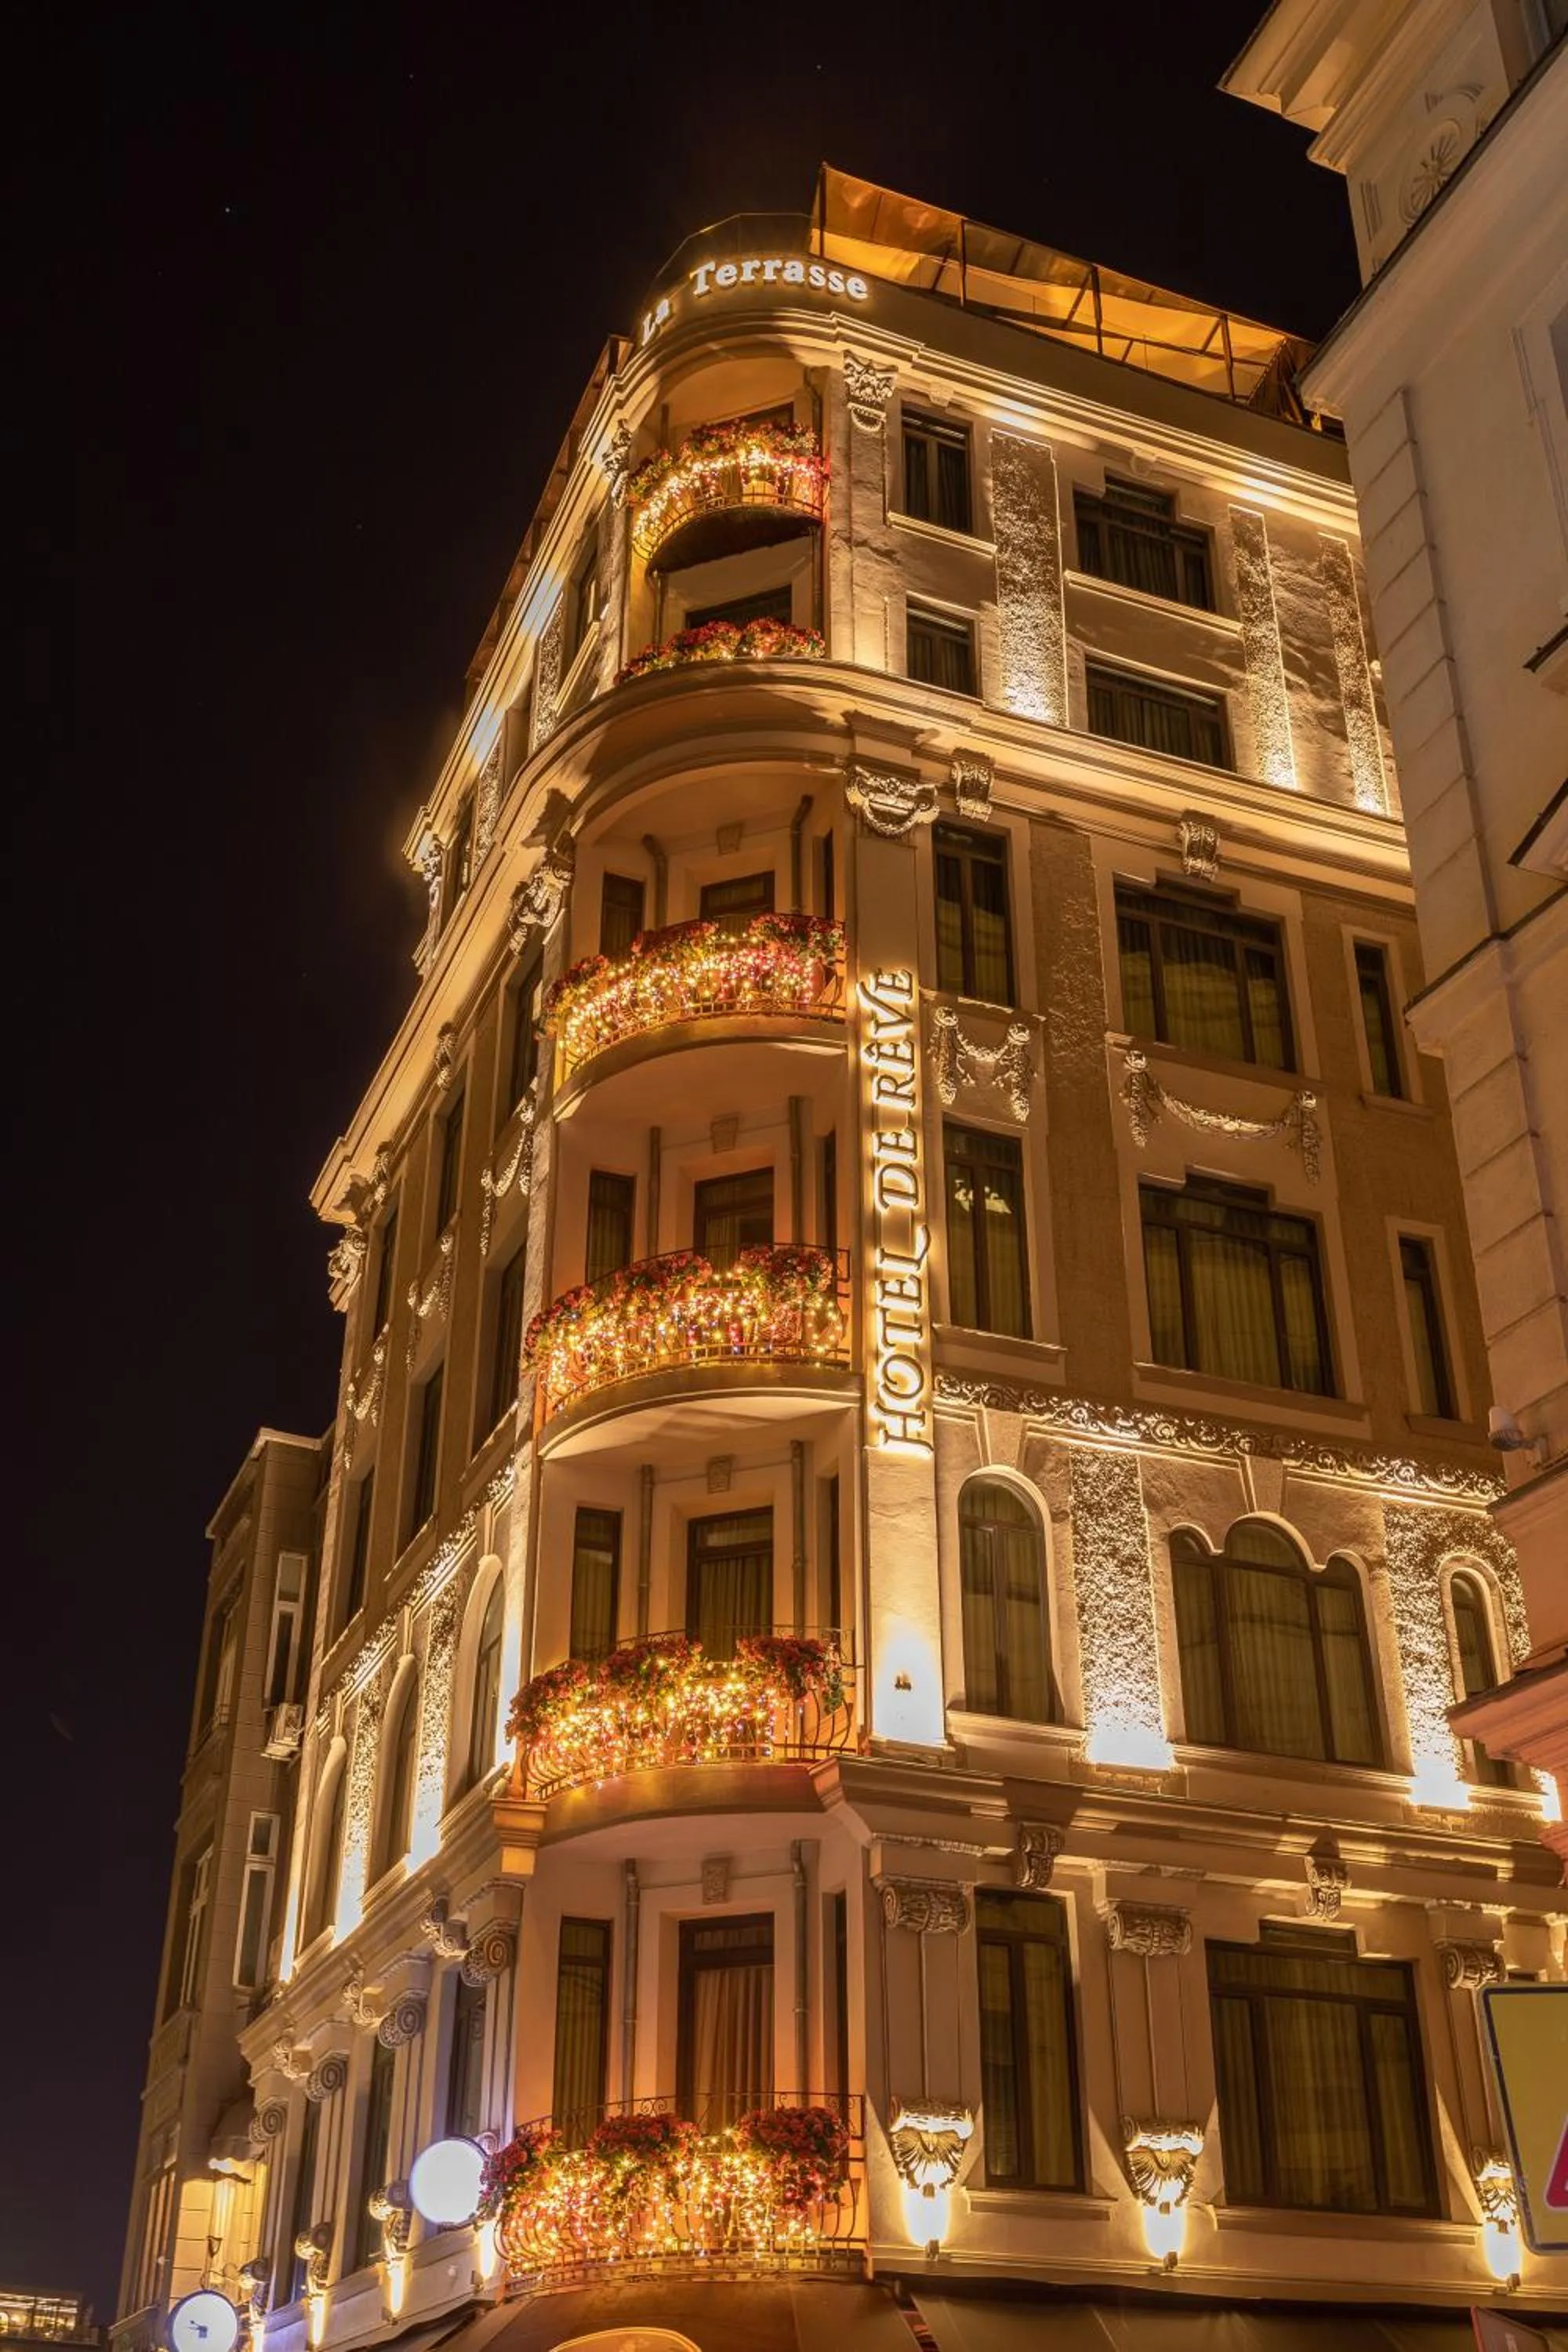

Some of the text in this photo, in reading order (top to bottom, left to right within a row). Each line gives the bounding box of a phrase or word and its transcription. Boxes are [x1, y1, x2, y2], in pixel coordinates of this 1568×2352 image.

[690, 260, 869, 299] Terrasse
[858, 967, 934, 1451] HOTEL DE RÊVE
